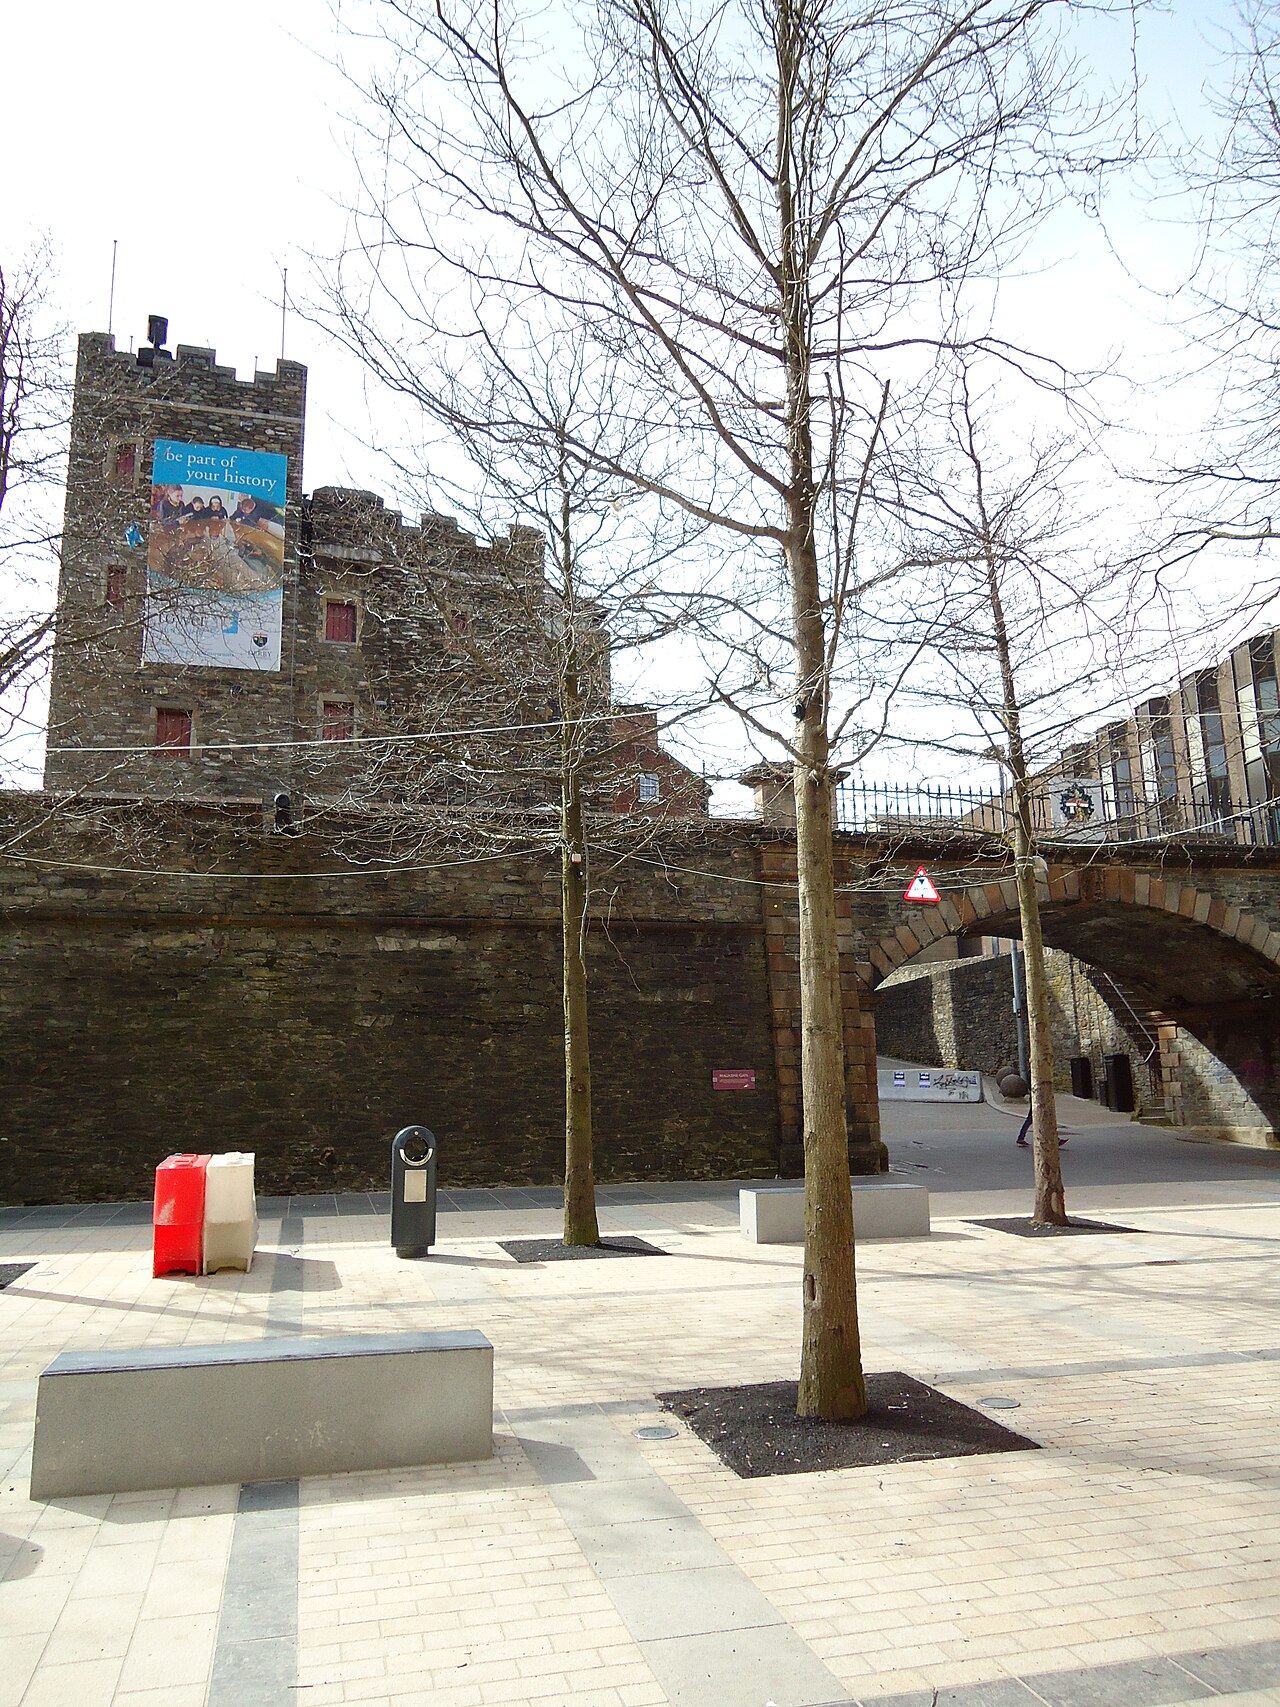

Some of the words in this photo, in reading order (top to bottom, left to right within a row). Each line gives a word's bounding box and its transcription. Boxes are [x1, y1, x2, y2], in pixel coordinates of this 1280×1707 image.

[166, 447, 183, 462] be
[187, 454, 216, 467] part
[221, 455, 238, 468] of
[186, 469, 220, 482] your
[224, 469, 277, 491] history
